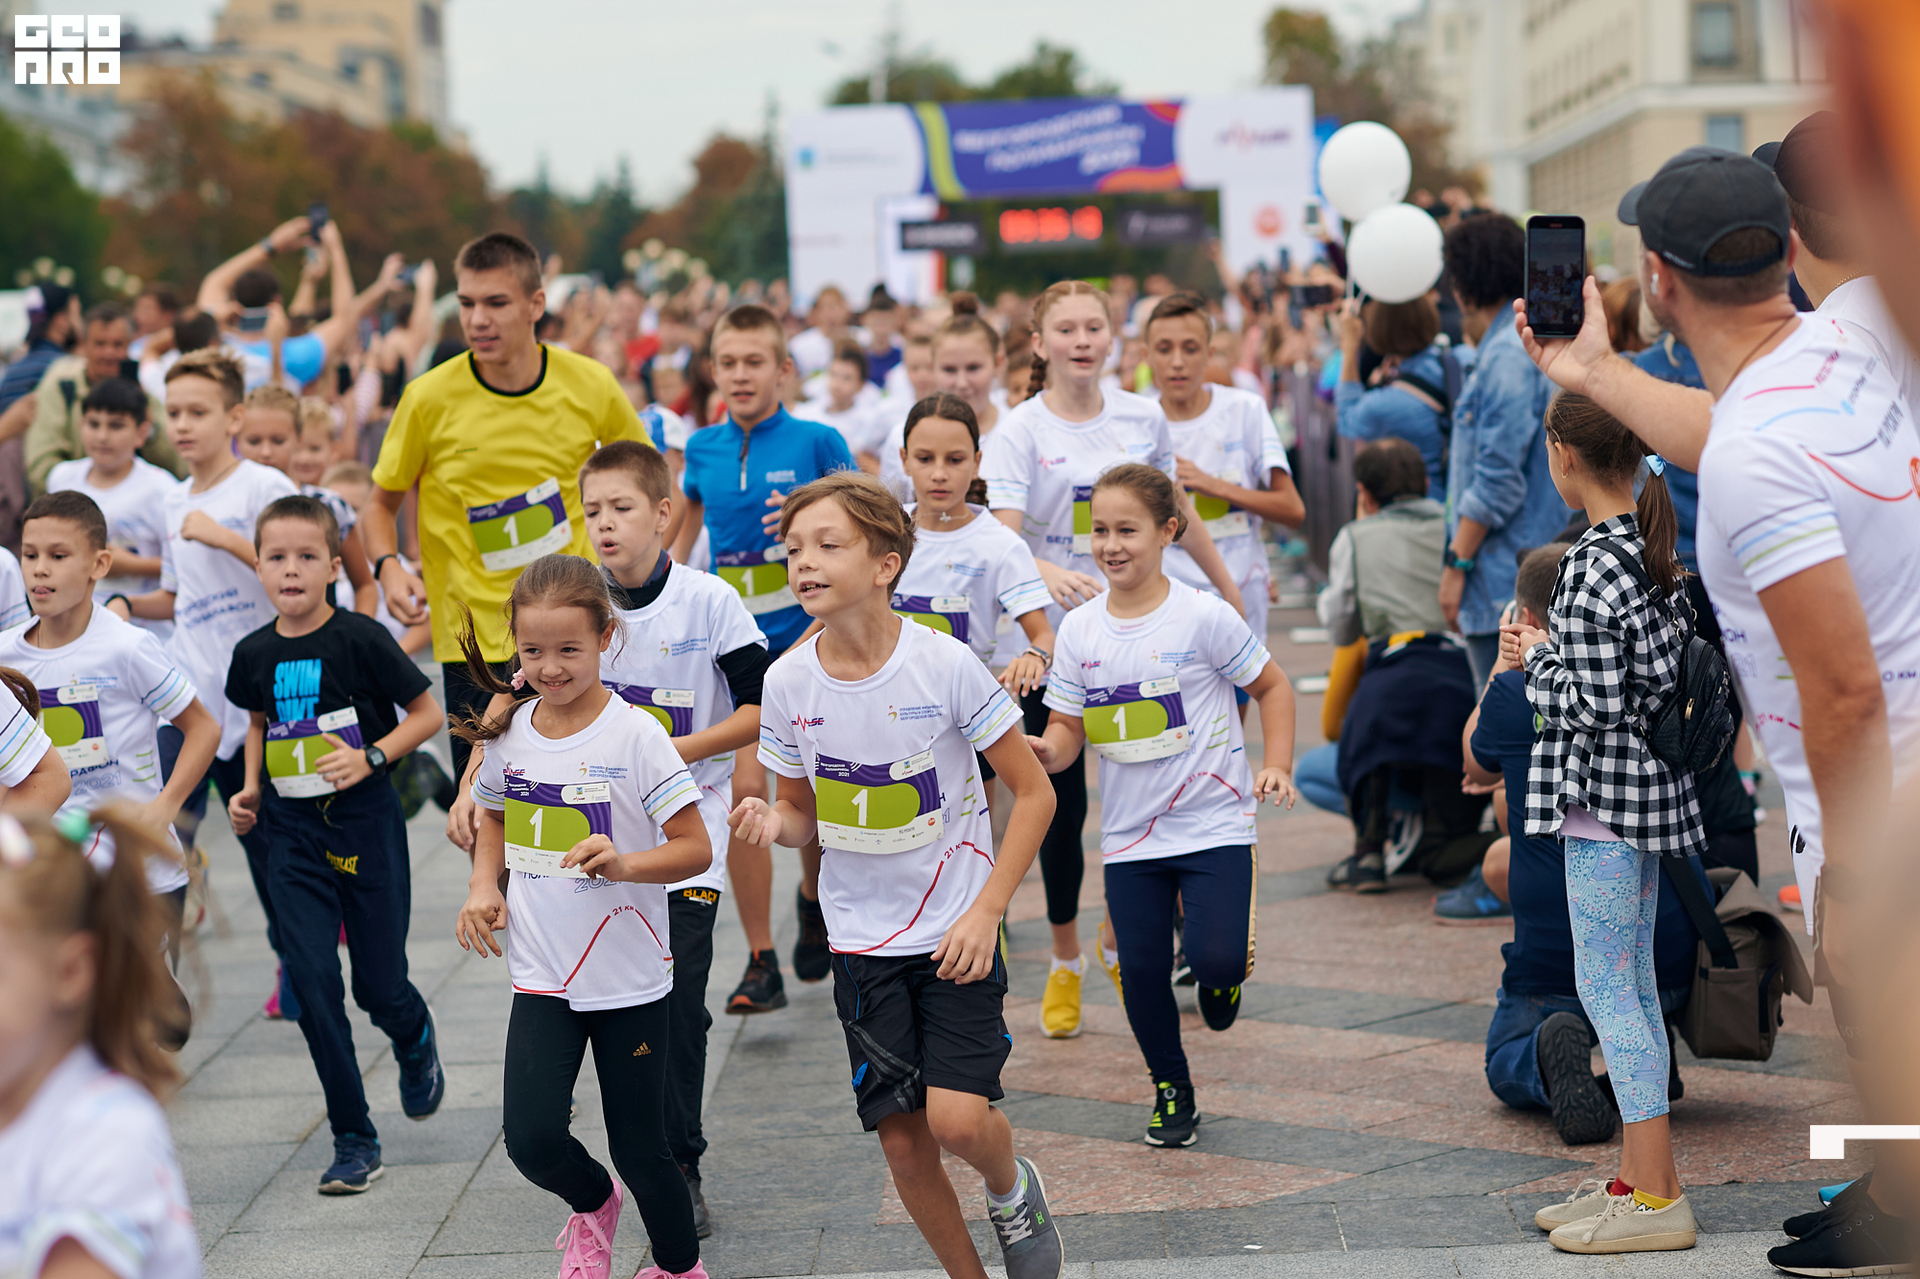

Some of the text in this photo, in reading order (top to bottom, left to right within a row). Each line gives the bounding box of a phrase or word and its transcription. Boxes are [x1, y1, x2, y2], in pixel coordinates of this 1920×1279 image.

[503, 515, 519, 547] 1
[741, 568, 755, 596] 1
[273, 658, 322, 699] SWIM
[1112, 706, 1128, 740] 1
[292, 740, 306, 774] 1
[851, 788, 868, 827] 1
[529, 808, 543, 847] 1
[944, 847, 954, 859] 21
[612, 906, 623, 916] 21
